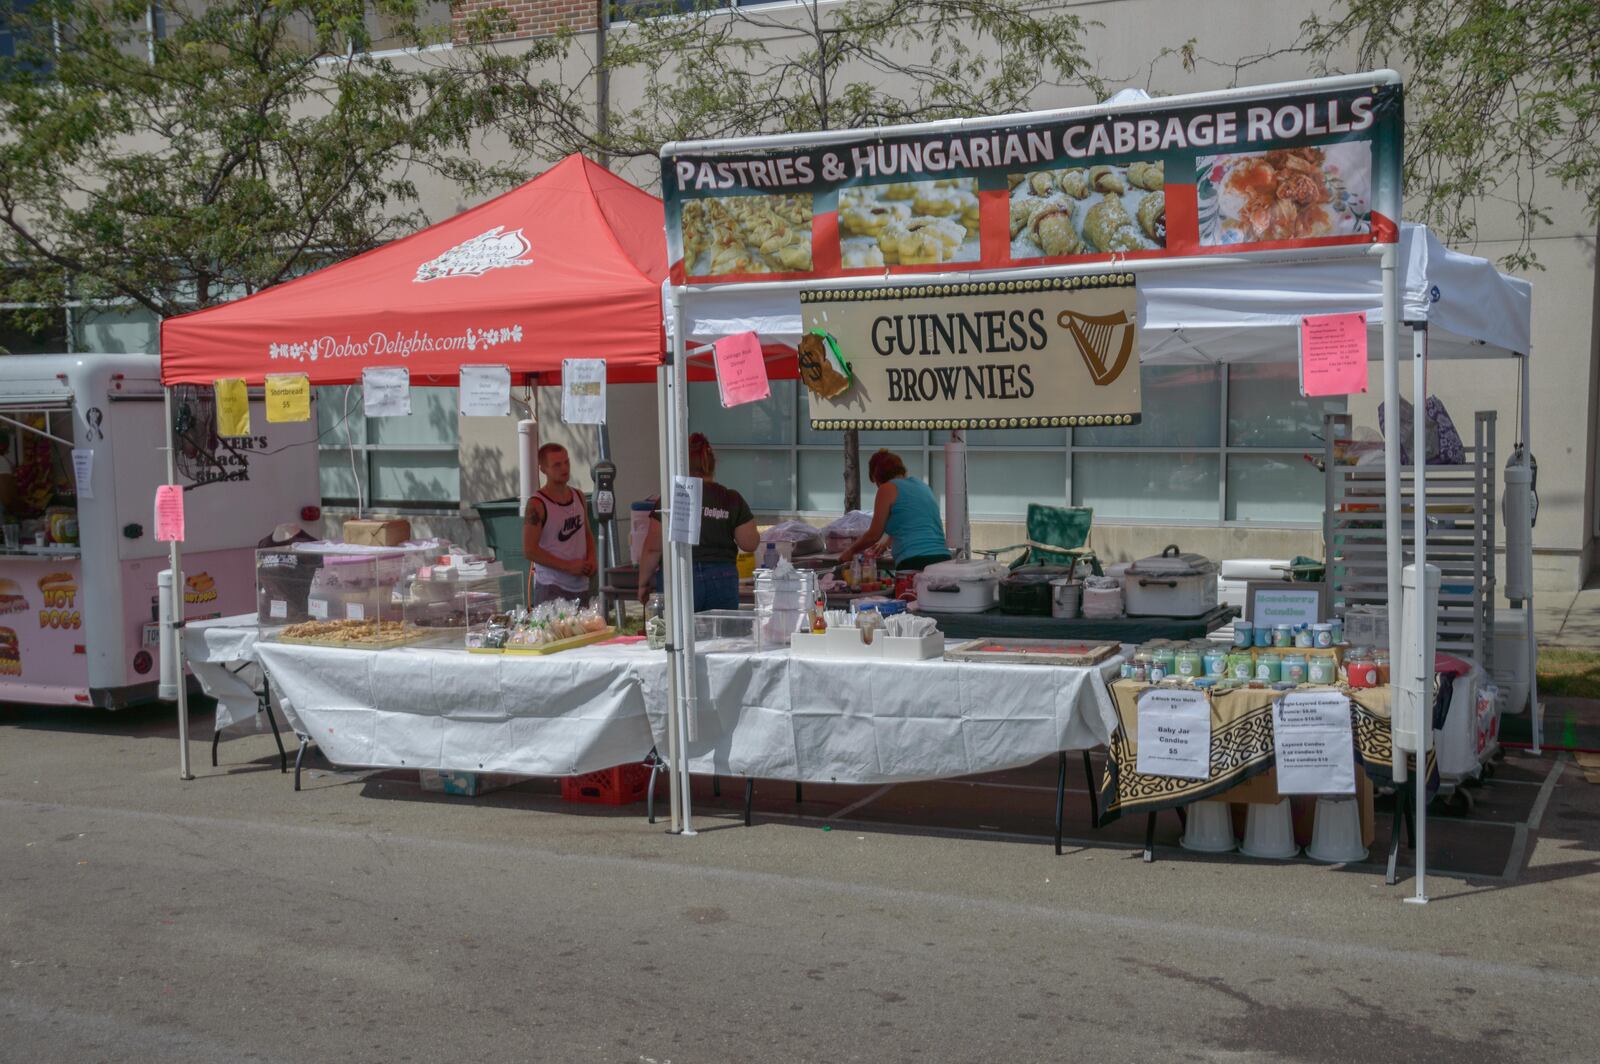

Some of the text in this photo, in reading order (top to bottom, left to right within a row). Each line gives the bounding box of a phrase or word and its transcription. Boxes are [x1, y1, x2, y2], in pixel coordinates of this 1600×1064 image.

[675, 96, 1375, 191] PASTRIES & HUNGARIAN CABBAGE ROLLS
[871, 308, 1048, 356] GUINNESS
[886, 364, 1035, 402] BROWNIES
[270, 388, 304, 397] Shortbread
[563, 515, 583, 532] NIKE
[43, 589, 78, 608] HOT
[38, 609, 82, 630] DOGS
[1157, 726, 1190, 735] Baby Jar
[1159, 736, 1189, 745] Candles
[1168, 747, 1178, 755] $5
